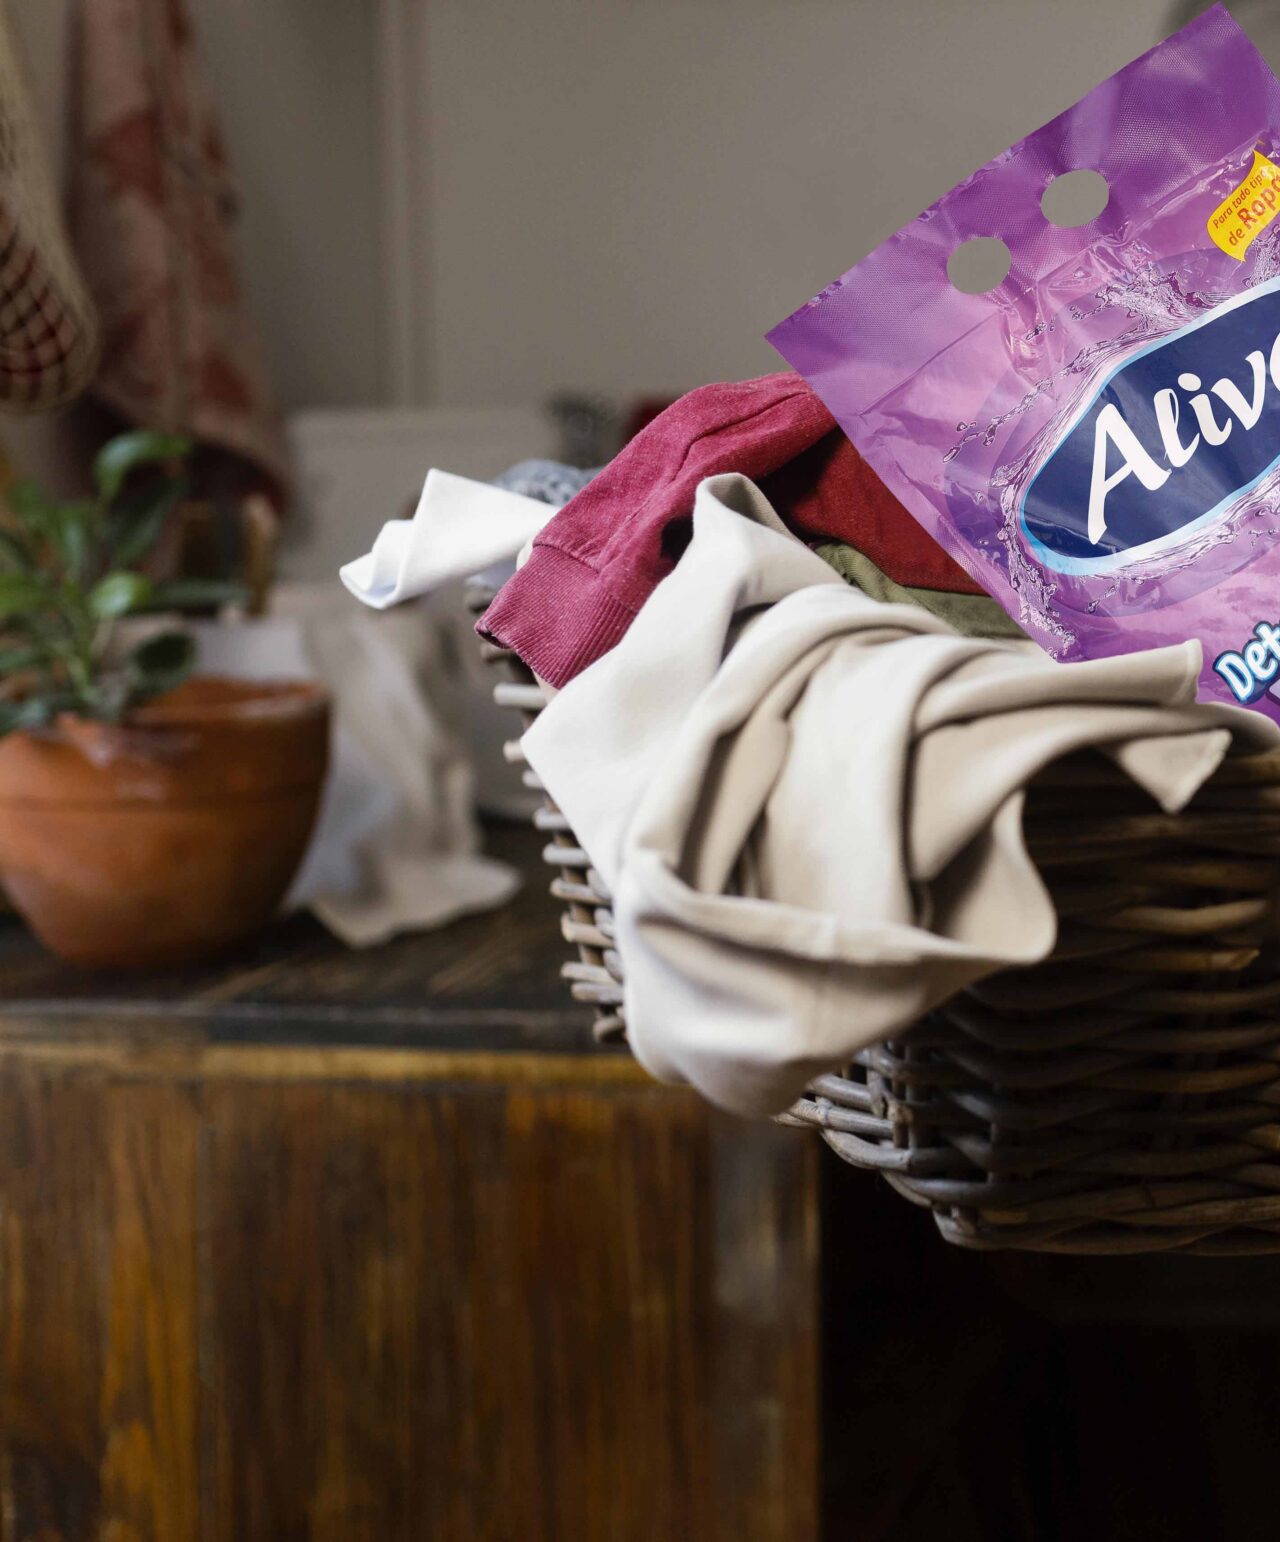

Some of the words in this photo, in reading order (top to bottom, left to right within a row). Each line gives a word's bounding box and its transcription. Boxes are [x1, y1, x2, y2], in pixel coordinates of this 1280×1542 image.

[1213, 208, 1233, 229] Para
[1232, 187, 1251, 208] todo
[1229, 227, 1245, 246] de
